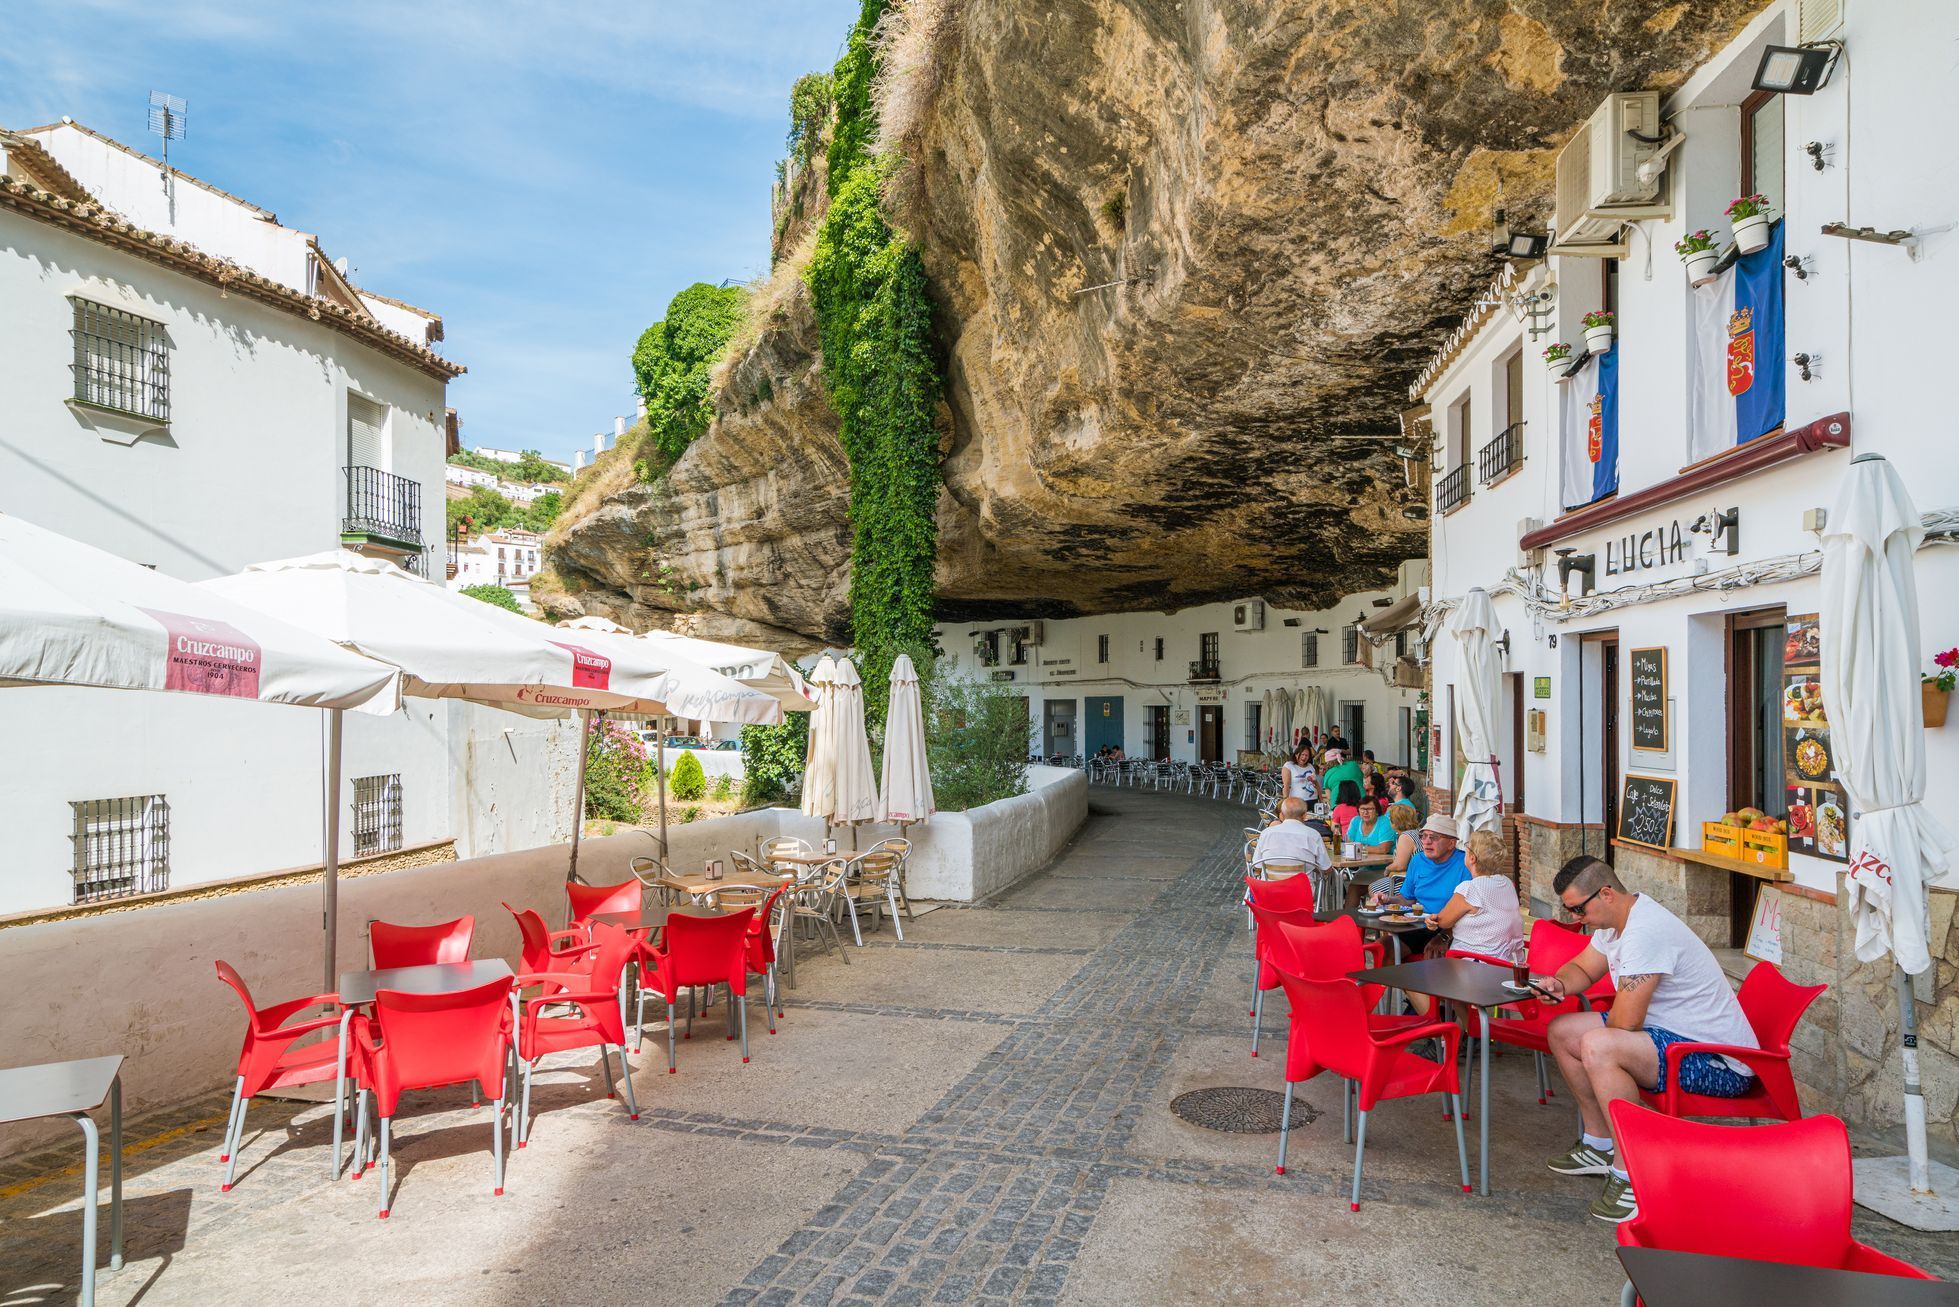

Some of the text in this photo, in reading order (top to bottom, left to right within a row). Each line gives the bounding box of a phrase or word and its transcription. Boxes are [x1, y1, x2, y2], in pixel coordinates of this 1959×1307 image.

[1606, 520, 1682, 576] LUCIA
[1548, 634, 1557, 648] 79
[177, 635, 254, 663] Cruzcampo
[173, 657, 212, 667] MAESTROS
[213, 662, 256, 673] CERVECEROS
[207, 671, 224, 679] 1904
[535, 693, 590, 706] Cruzcampo
